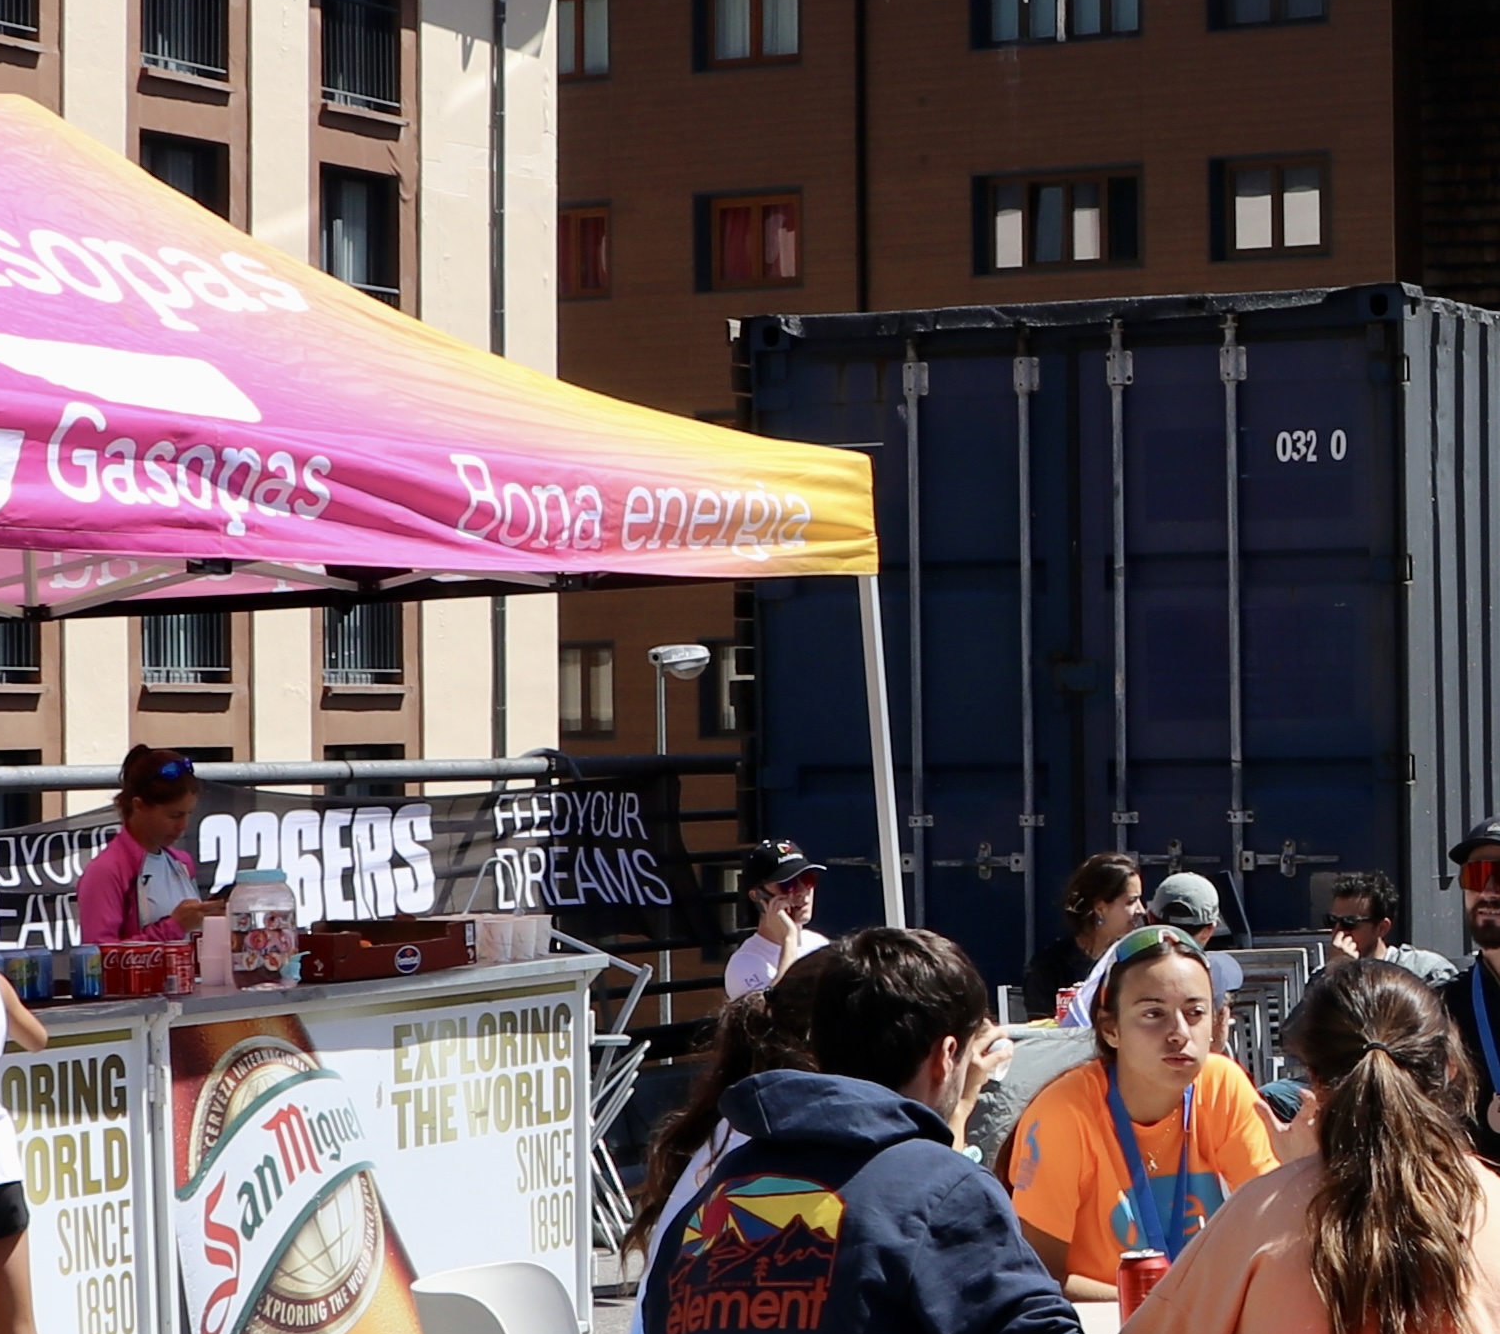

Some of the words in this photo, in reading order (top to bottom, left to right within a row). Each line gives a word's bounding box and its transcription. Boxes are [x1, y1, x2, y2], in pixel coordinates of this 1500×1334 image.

[47, 402, 332, 536] Gasopas
[1275, 430, 1318, 463] 032
[1331, 428, 1347, 462] 0
[451, 454, 602, 549] Bona
[621, 482, 812, 561] energia
[495, 845, 673, 911] DREAMS
[392, 1003, 573, 1085] EXPLORING
[0, 1054, 128, 1131] ORING
[204, 1078, 237, 1148] CERVEZA
[233, 1048, 311, 1080] INTERNACIONA
[391, 1083, 459, 1150] THE
[463, 1066, 573, 1138] WORLD
[17, 1127, 131, 1206] ORLD
[516, 1128, 573, 1194] SINCE
[57, 1198, 133, 1277] SINCE
[529, 1190, 574, 1255] 1890
[328, 1286, 351, 1316] THE
[348, 1247, 373, 1297] WORLD
[362, 1210, 376, 1252] SINCE
